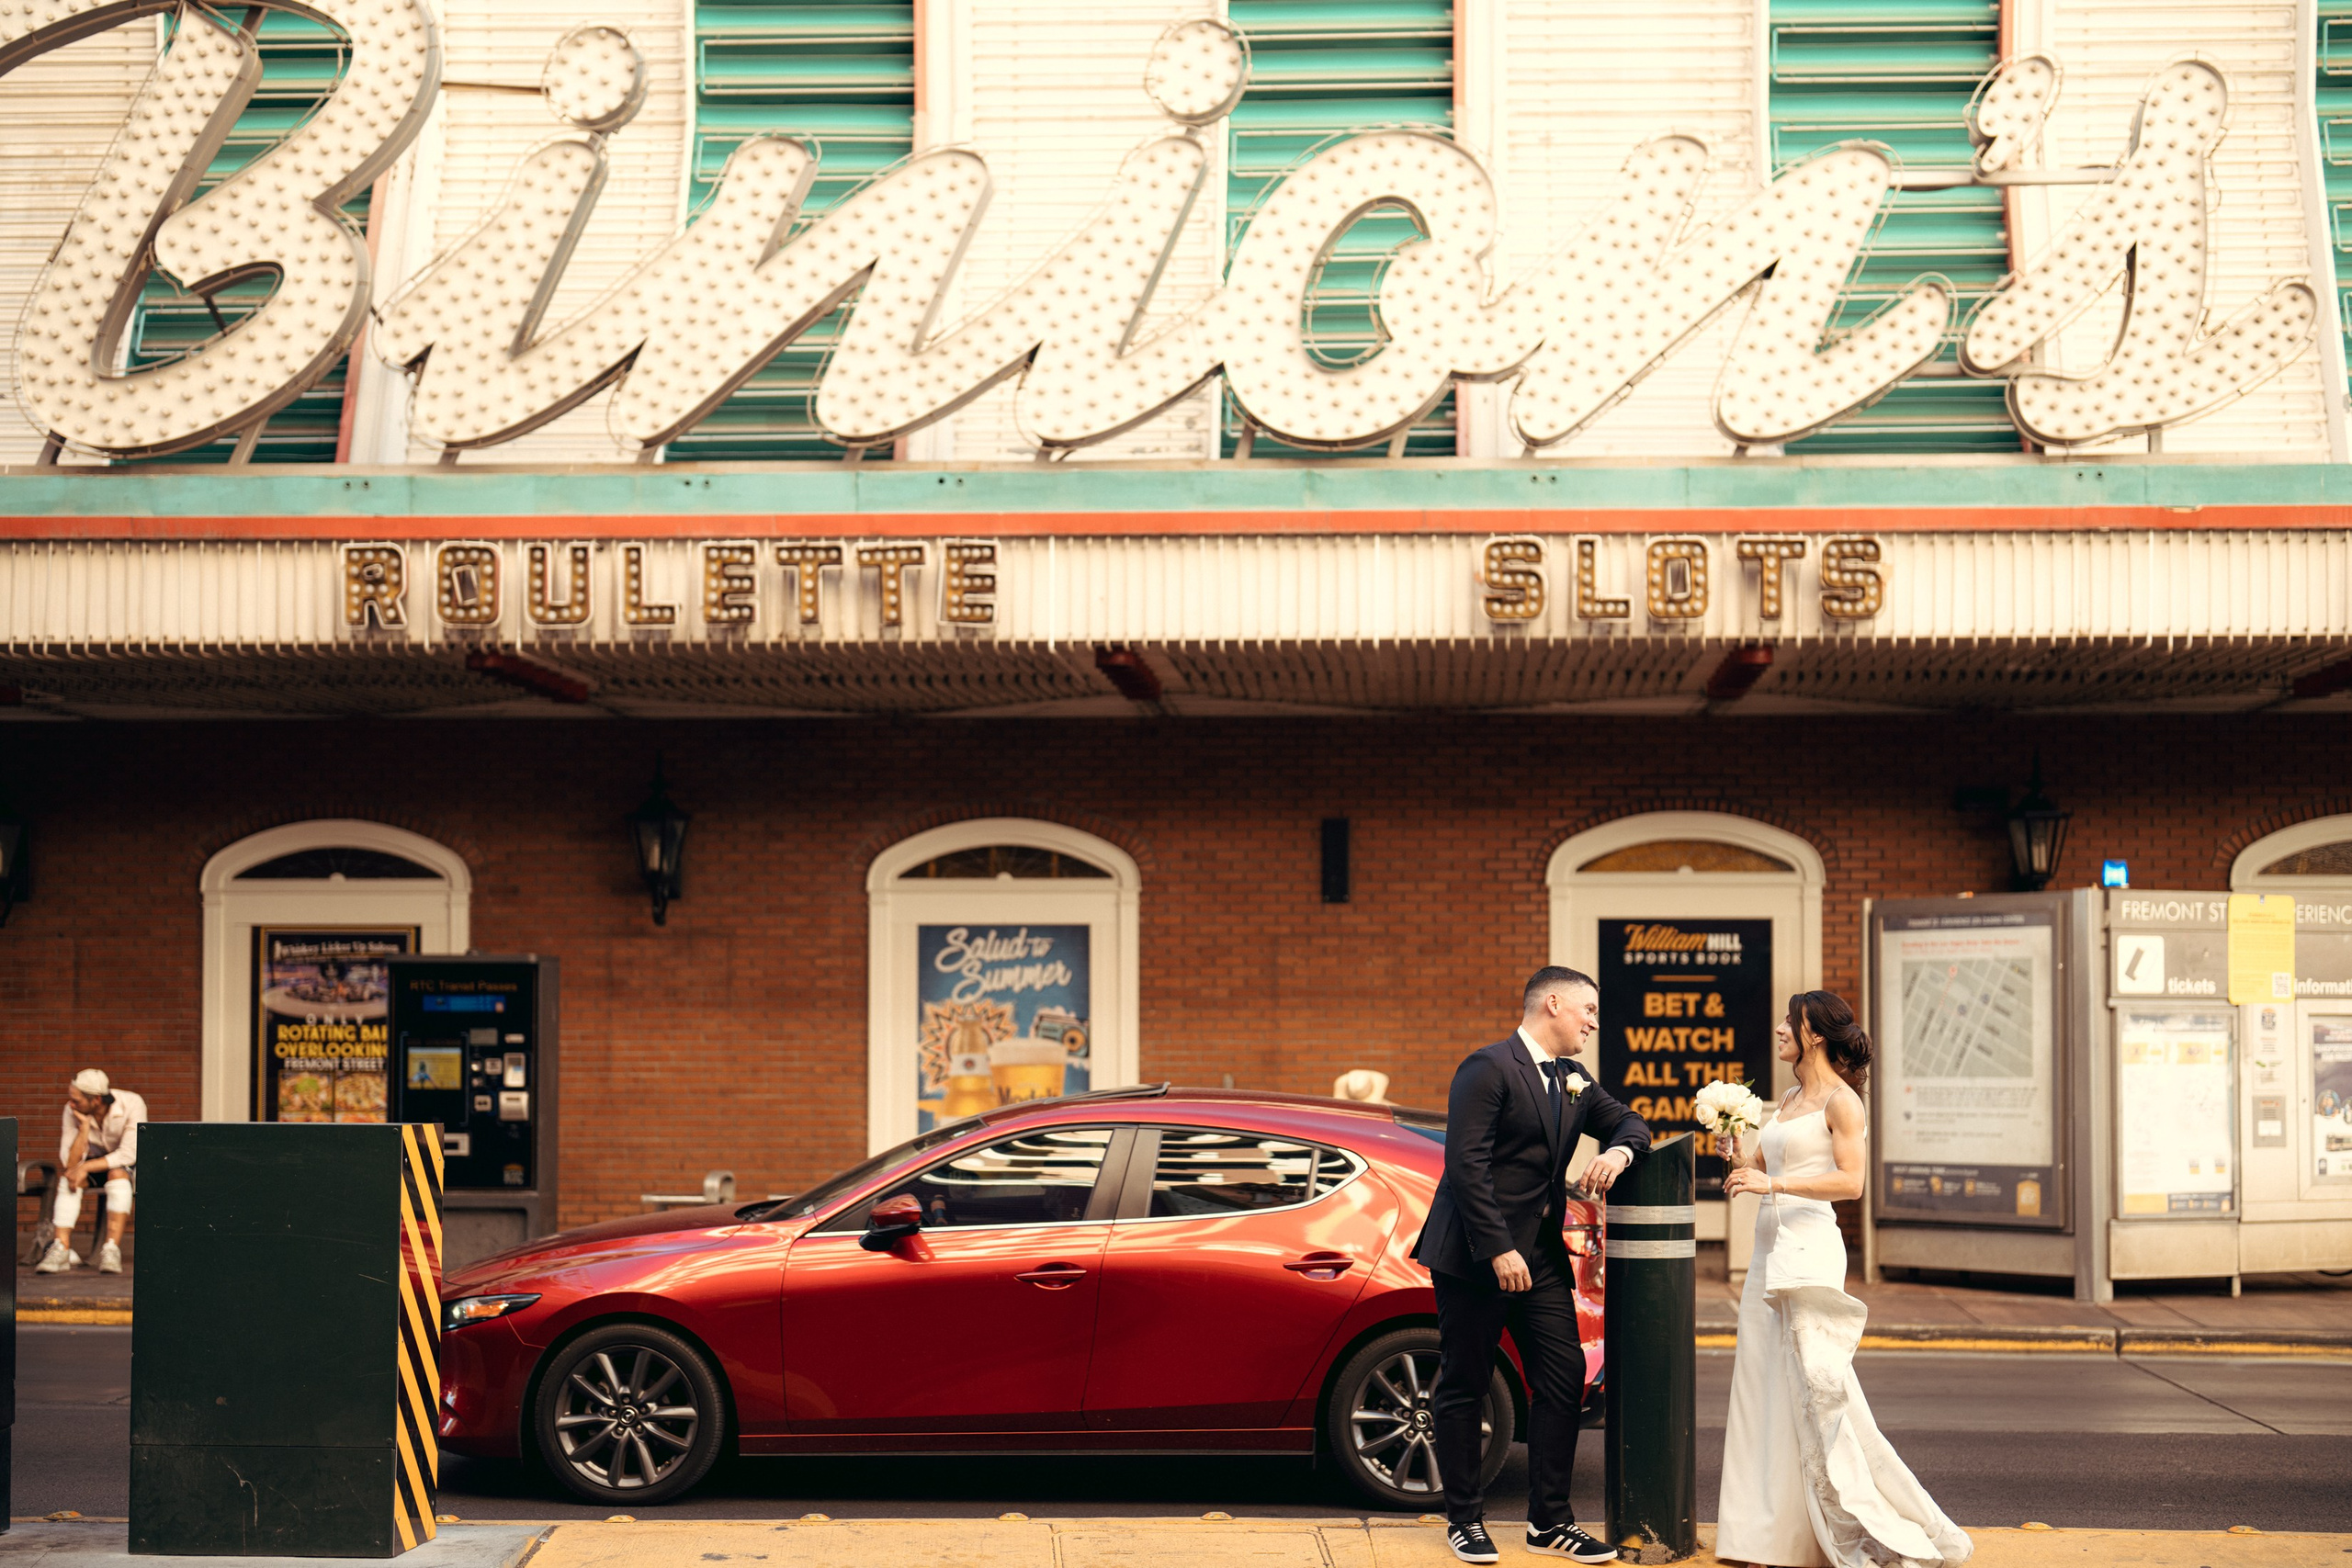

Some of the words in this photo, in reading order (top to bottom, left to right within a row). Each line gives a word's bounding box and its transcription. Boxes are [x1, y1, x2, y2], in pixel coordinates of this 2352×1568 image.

[0, 0, 2321, 454] Binion's
[340, 539, 1001, 631] ROULETTE
[1482, 535, 1885, 624] SLOTS
[2120, 900, 2205, 922] FREMONT
[2294, 904, 2352, 925] ERIENC
[934, 927, 1030, 973] Salud
[1026, 937, 1055, 957] to
[1706, 932, 1742, 952] HILL
[1623, 952, 1690, 965] SPORTS
[1694, 952, 1742, 965] BOOK
[951, 959, 1073, 1005] Summer
[2167, 977, 2217, 995] tickets
[1644, 992, 1702, 1018] BET
[1703, 992, 1725, 1018] &
[305, 1012, 365, 1026] ONLY
[277, 1024, 357, 1042] ROTATING
[1624, 1026, 1736, 1053] WATCH
[284, 1056, 340, 1072] FREMONT
[342, 1056, 385, 1072] STREET
[1623, 1061, 1680, 1088] ALL
[1683, 1061, 1745, 1088] THE
[1629, 1095, 1697, 1122] GAM
